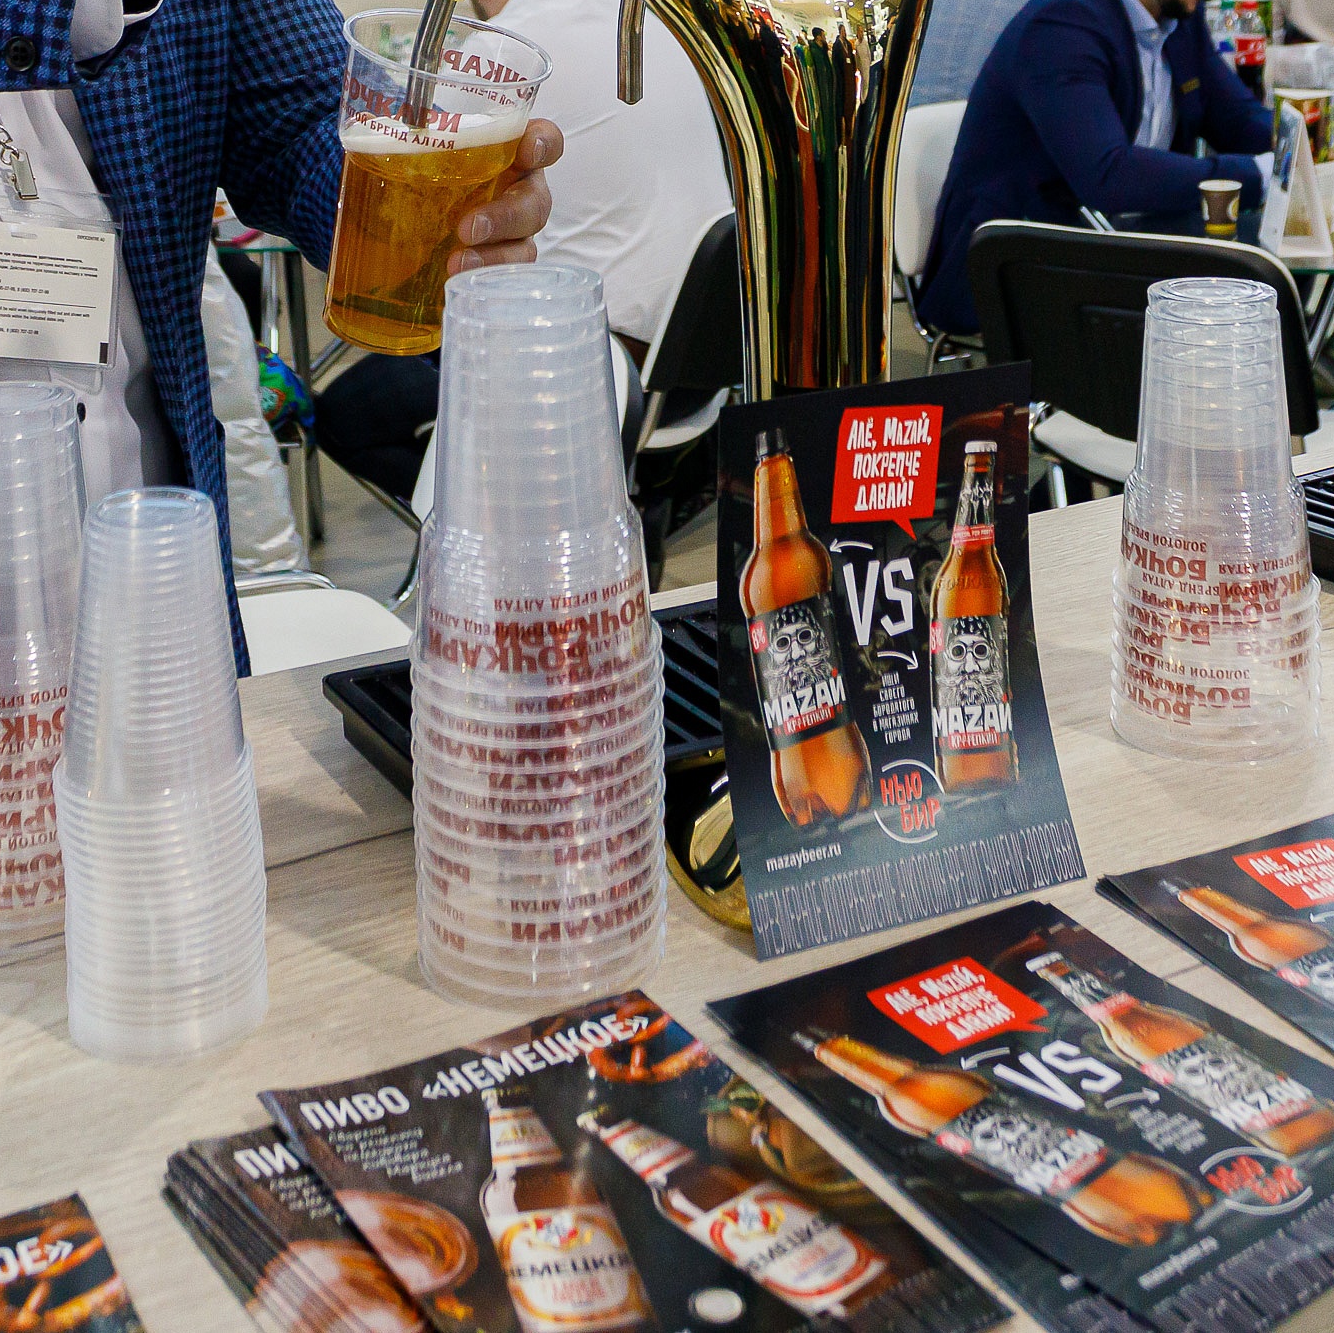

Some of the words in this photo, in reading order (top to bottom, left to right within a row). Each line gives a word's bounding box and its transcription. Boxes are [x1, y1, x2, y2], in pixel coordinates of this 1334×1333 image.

[370, 117, 408, 143] БРЕНД
[412, 131, 455, 150] АЛТАЯ
[847, 416, 877, 451] АЛЁ,
[853, 450, 921, 479] ПОКРЕПЧЕ
[854, 476, 914, 512] ДАВАЙ!
[1153, 535, 1207, 554] ЗОЛОТОЙ
[1219, 563, 1259, 574] АЛТАЯ
[1263, 554, 1293, 572] БРЕНД
[1142, 572, 1175, 588] АЛТАЯ
[1179, 581, 1220, 597] БРЕНД
[494, 598, 544, 613] АЛТАЯ
[550, 591, 598, 610] БРЕНД
[843, 557, 914, 645] VS
[751, 624, 766, 653] 8%
[881, 671, 900, 687] ИЩИ
[1190, 667, 1250, 681] ЗОЛОТОЙ
[879, 684, 906, 701] СВОЕГО
[873, 697, 915, 717] БОРОДАТОГО
[872, 718, 878, 732] В
[879, 711, 919, 731] МАГАЗИНАХ
[884, 727, 911, 744] ГОРОДА
[879, 770, 922, 805] НЬЮ
[900, 797, 940, 833] БИР
[766, 842, 842, 872] mazaybeer.ru
[750, 881, 827, 956] ЧРЕЗМЕРНОЕ
[819, 862, 902, 941] УПОТРЕБЛЕНИЕ
[895, 849, 951, 920] АЛКОГОЛЯ
[942, 841, 989, 908] ВРЕДИТ
[980, 832, 1028, 898] ВАШЕМУ
[1021, 818, 1082, 888] ЗДОРОВЬЮ
[299, 1085, 411, 1131] ПИВО
[422, 1013, 650, 1100] «НЕМЕЦКОЕ»
[992, 1040, 1122, 1110] VS
[234, 1142, 301, 1179] ПИ
